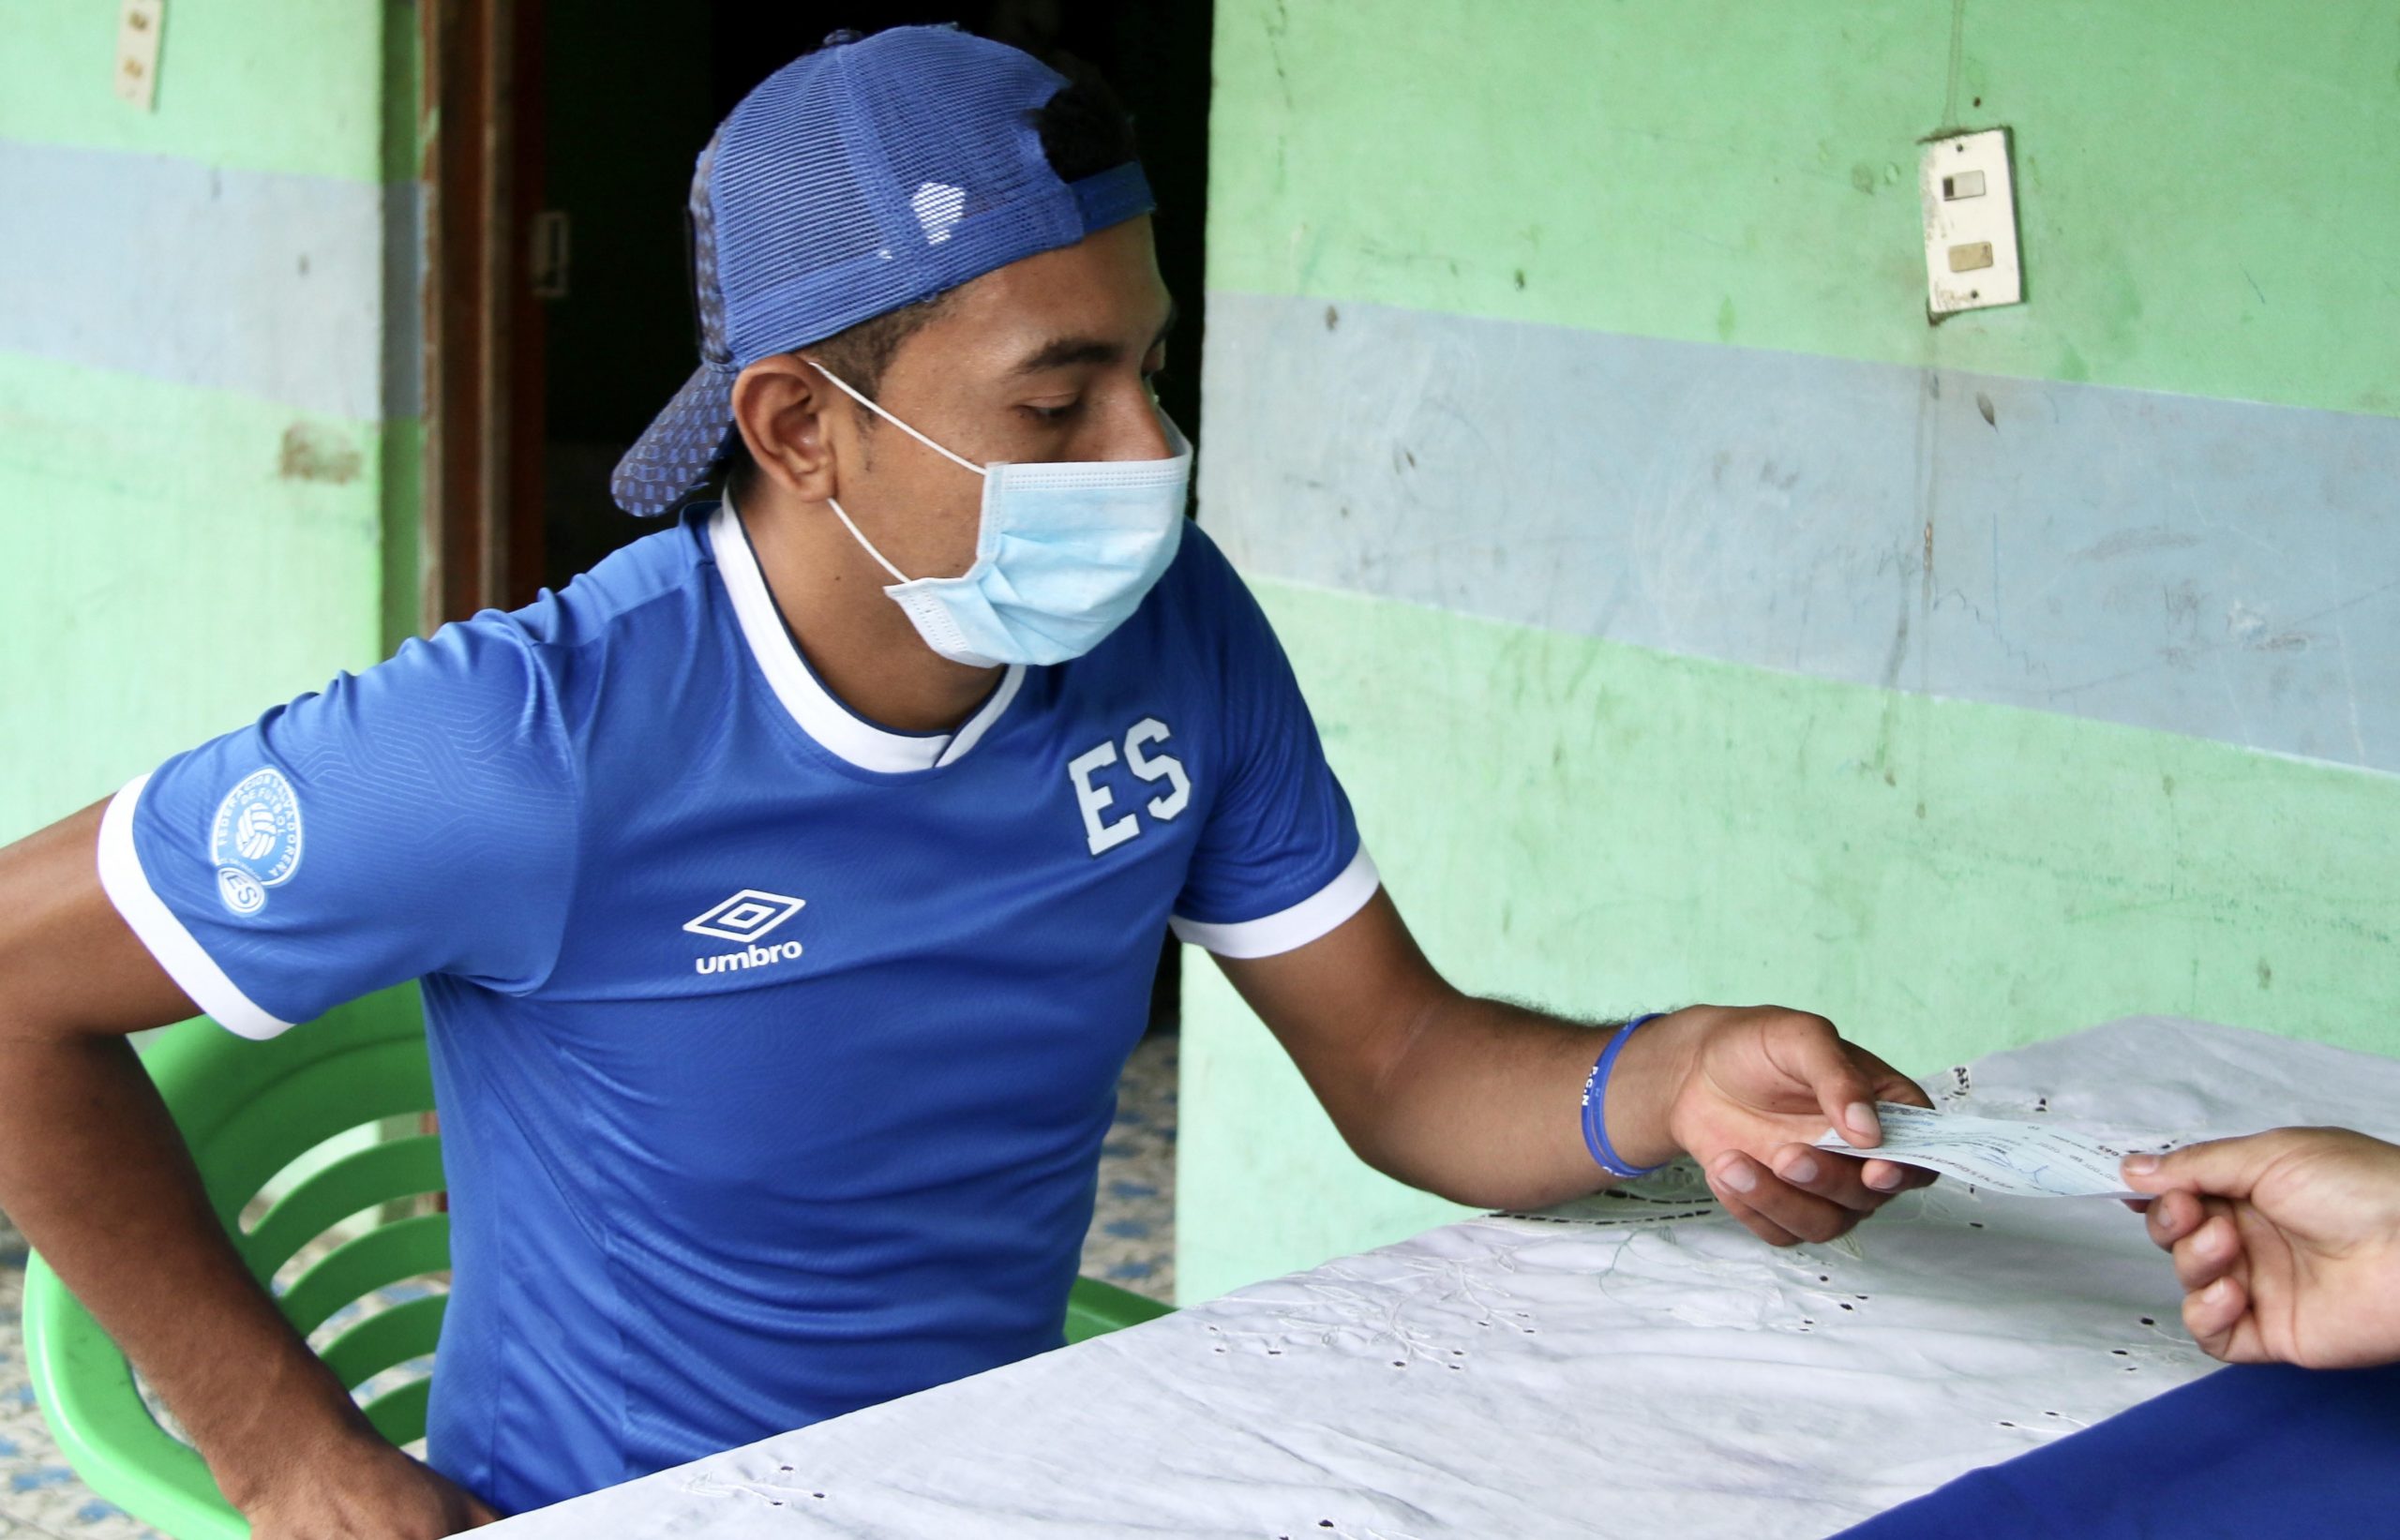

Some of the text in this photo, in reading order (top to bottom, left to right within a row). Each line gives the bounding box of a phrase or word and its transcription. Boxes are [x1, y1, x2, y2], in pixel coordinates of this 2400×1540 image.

[1067, 716, 1192, 857] ES
[258, 787, 287, 836] FUTBOL
[225, 875, 258, 905] ES
[696, 940, 802, 975] umbro
